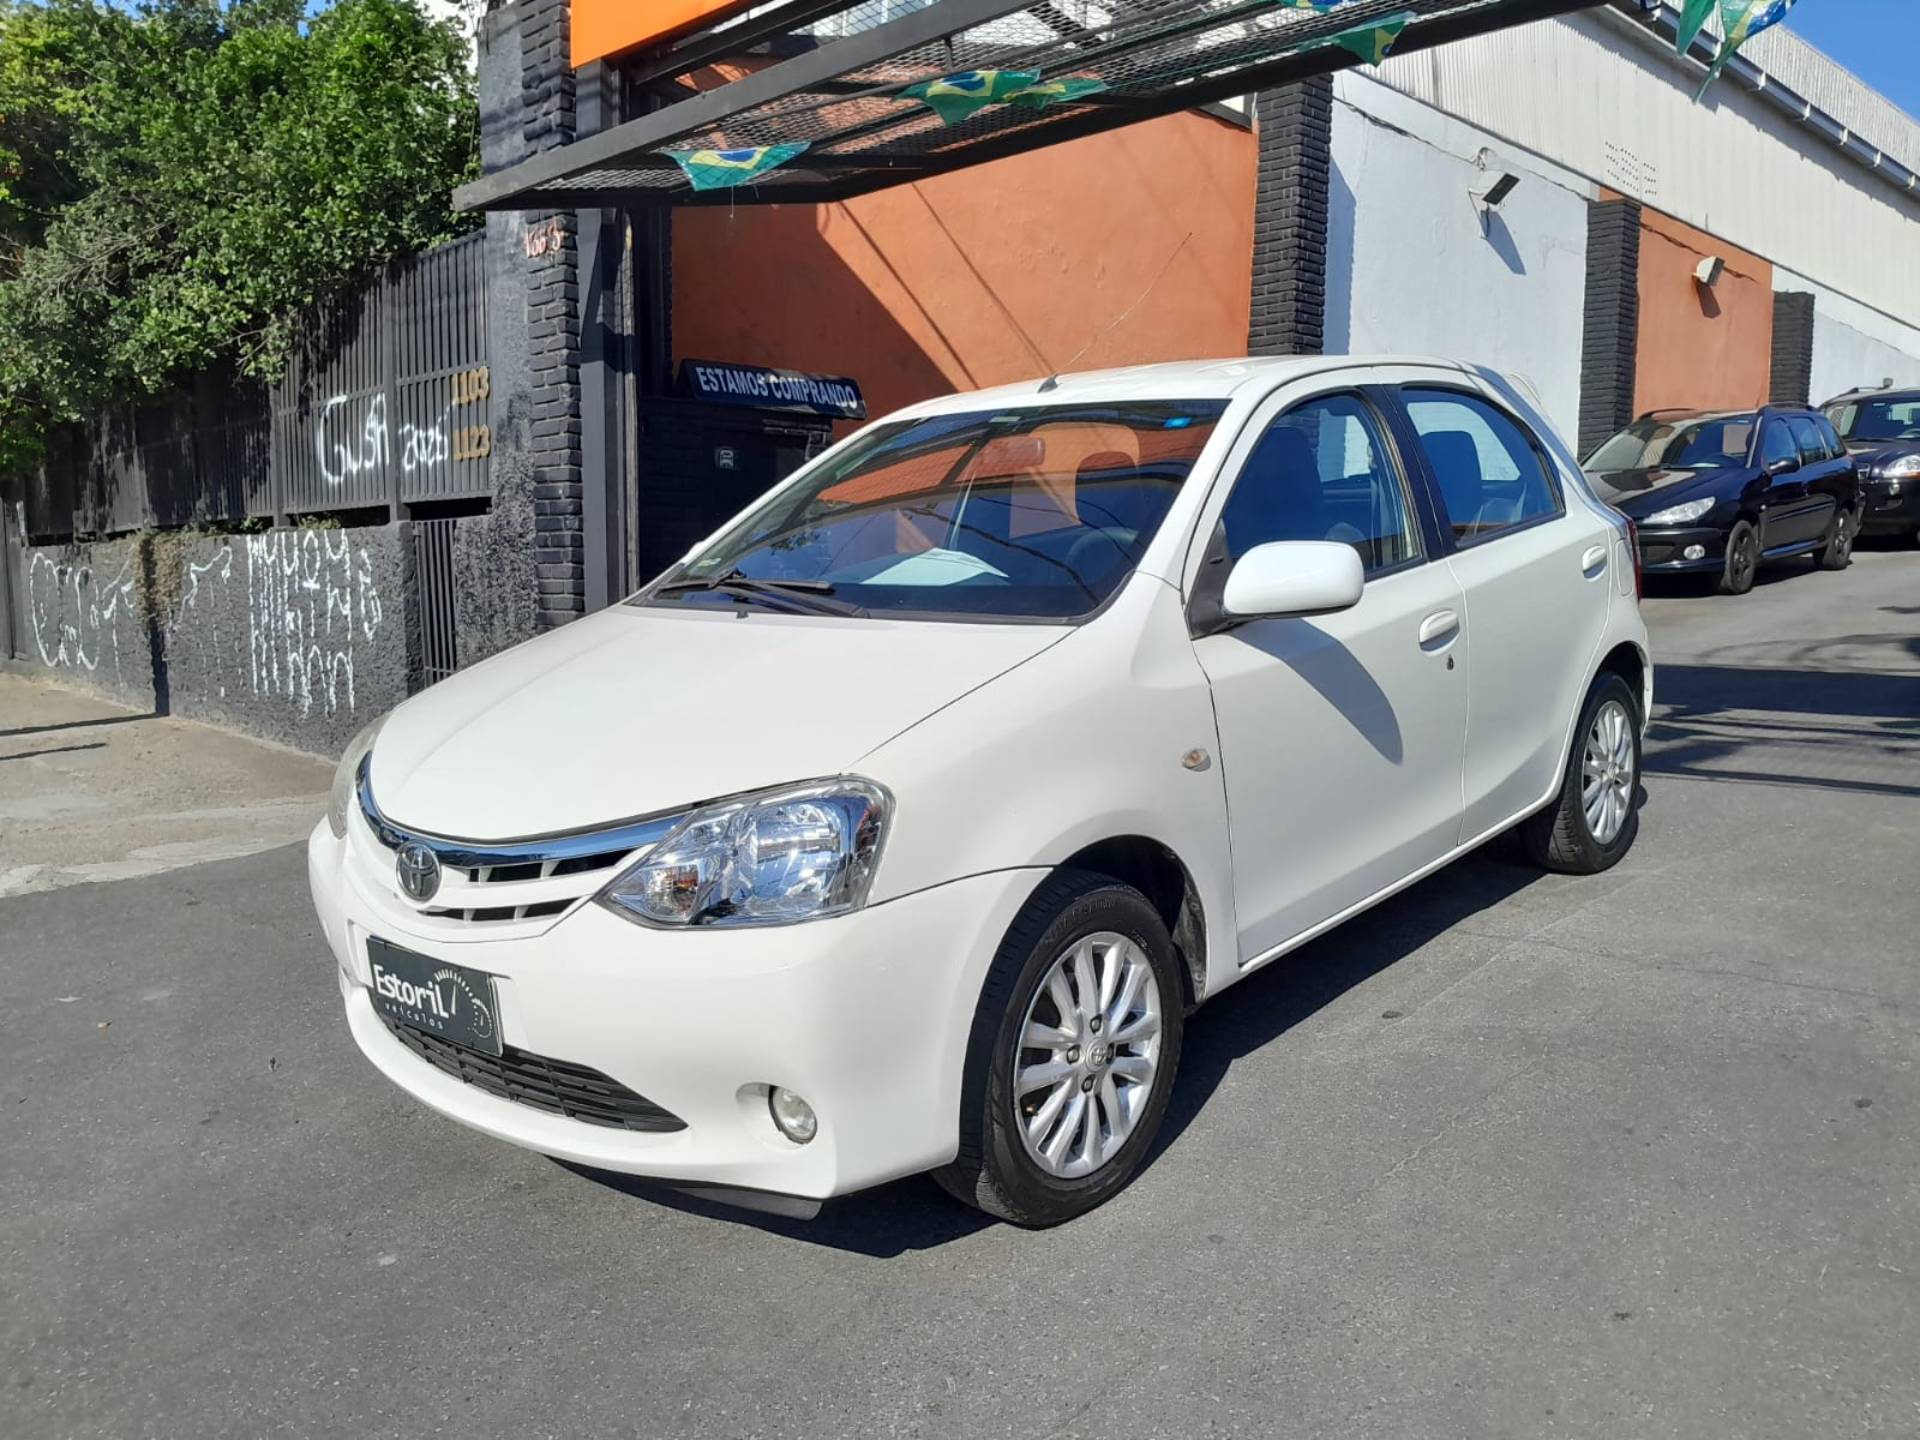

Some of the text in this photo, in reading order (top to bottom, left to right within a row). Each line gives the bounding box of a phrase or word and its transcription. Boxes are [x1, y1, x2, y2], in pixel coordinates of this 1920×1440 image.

[452, 366, 491, 405] 1103
[696, 366, 858, 409] ESTAMOS COMPRANDO
[453, 423, 491, 462] 1123
